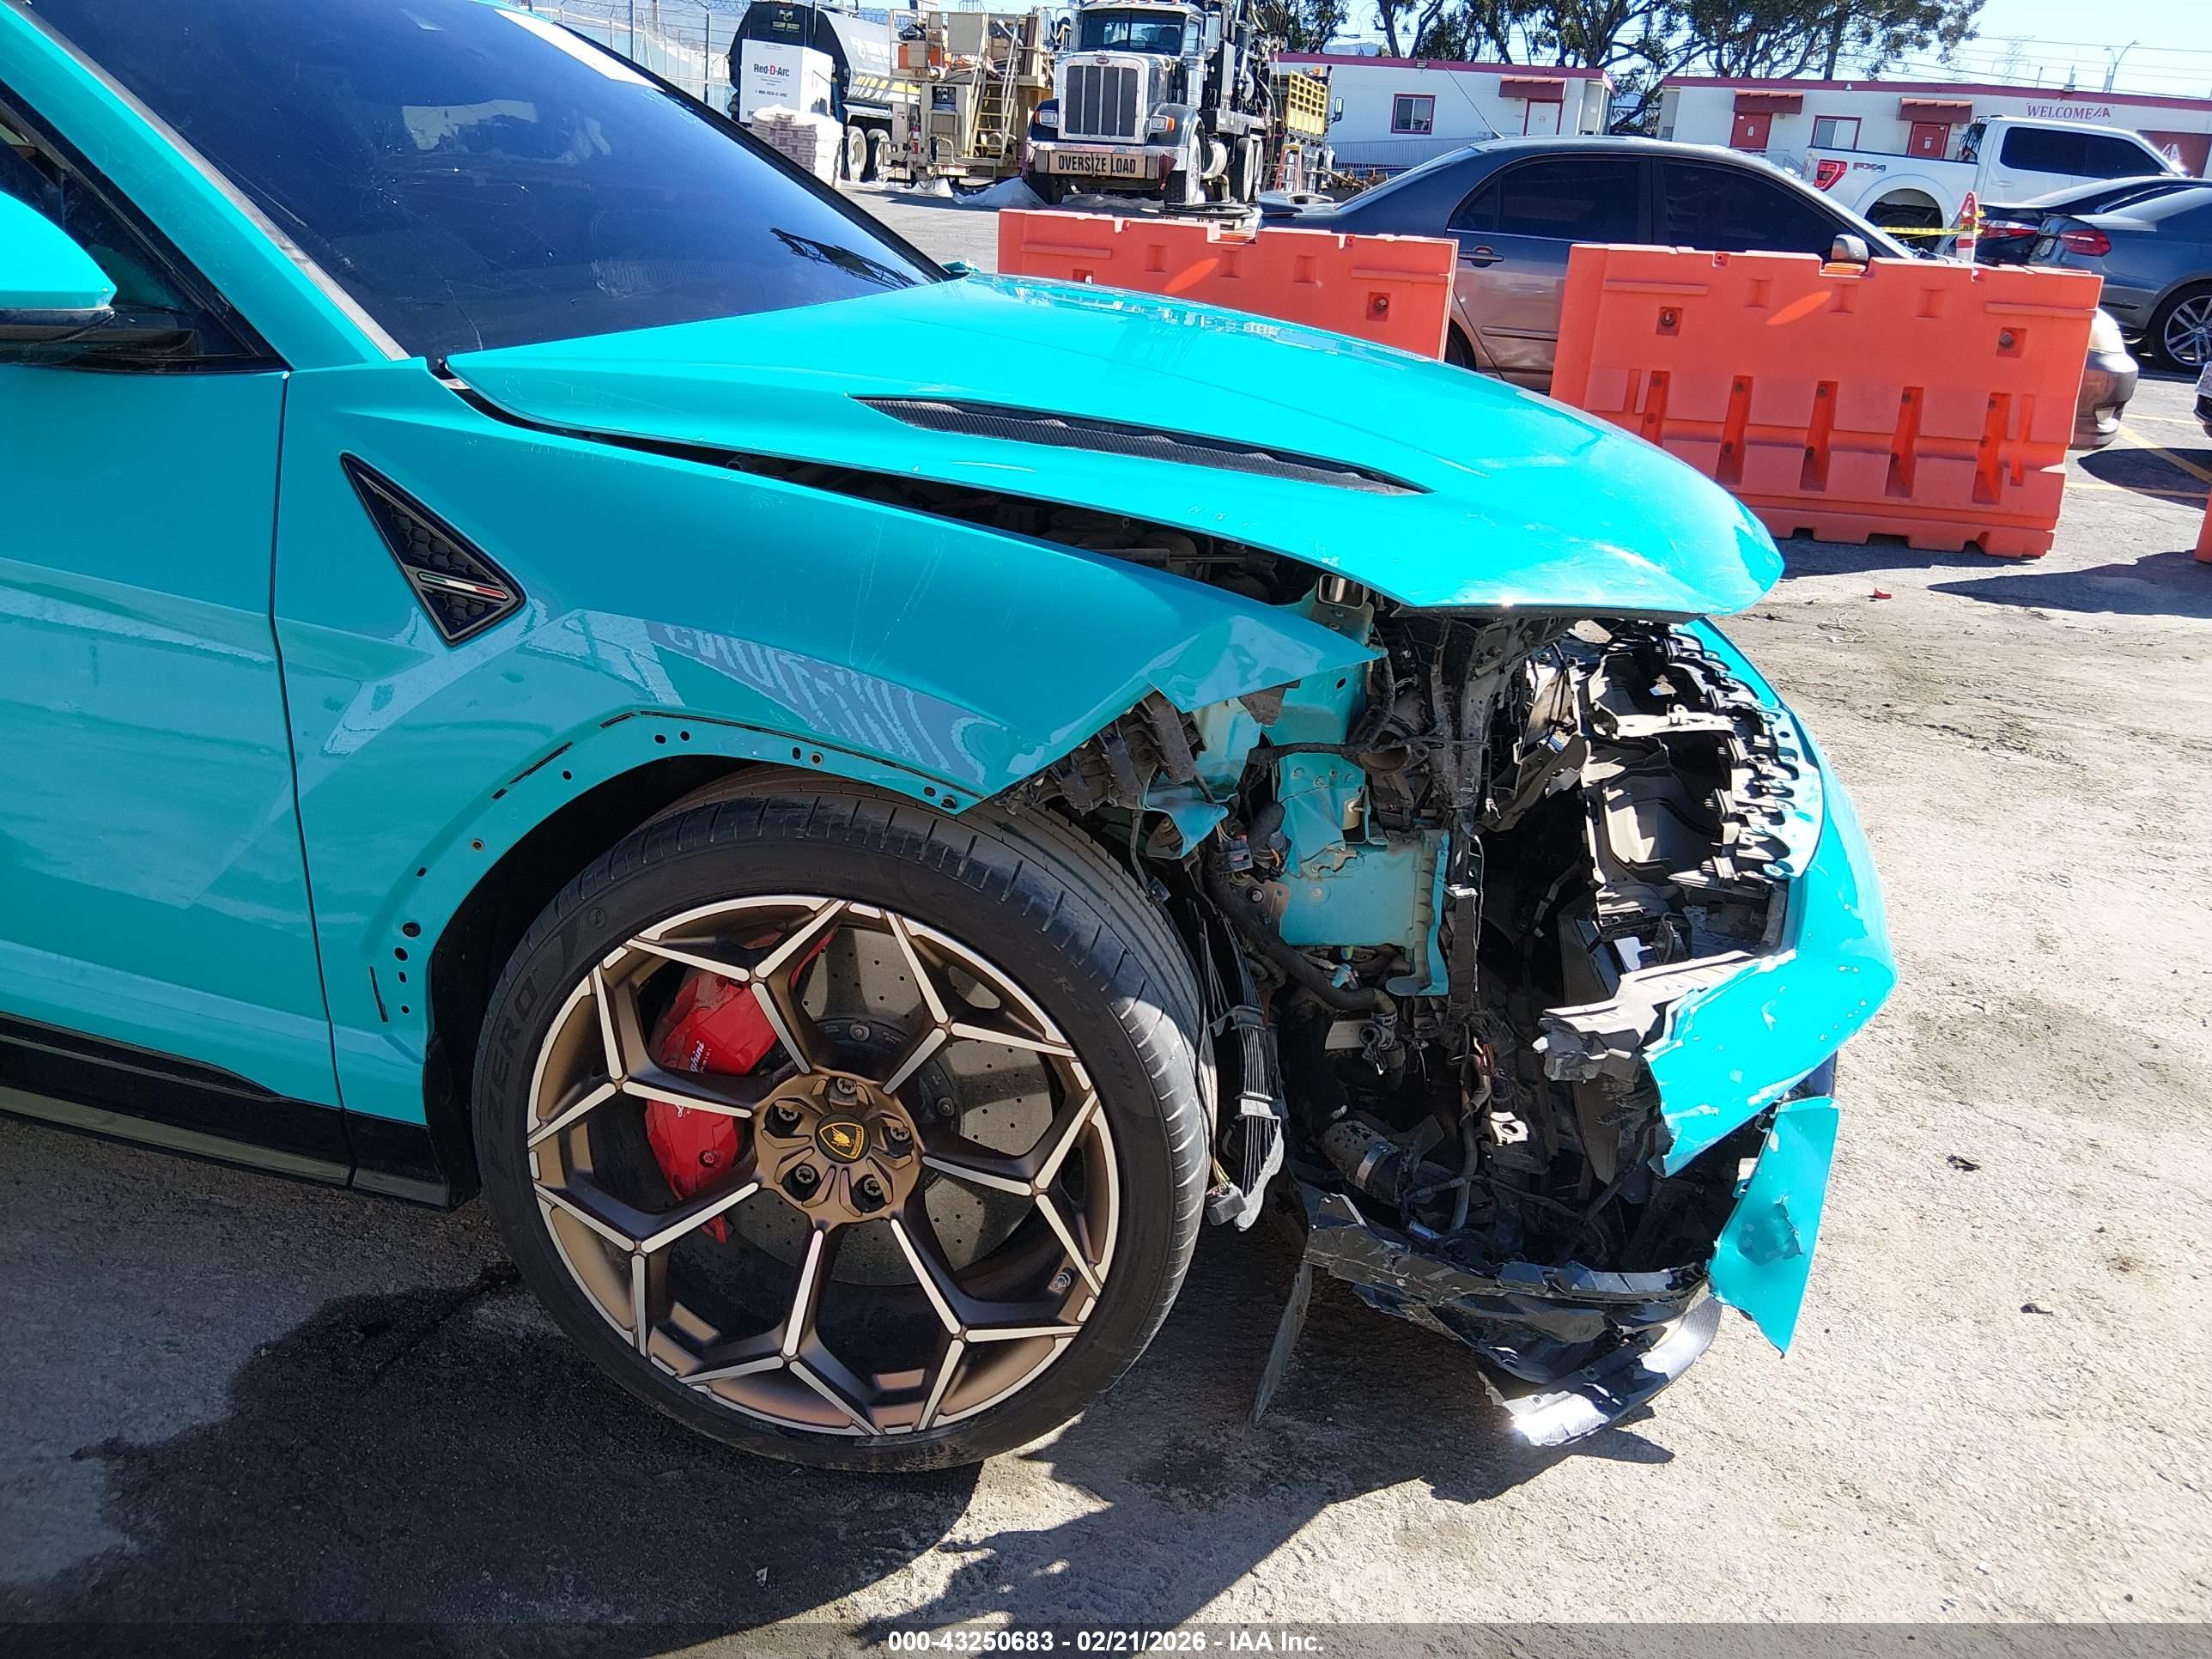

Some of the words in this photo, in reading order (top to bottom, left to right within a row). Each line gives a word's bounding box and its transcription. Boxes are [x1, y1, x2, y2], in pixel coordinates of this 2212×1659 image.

[2027, 104, 2094, 120] WELCOME
[1058, 155, 1107, 173] OVERSIZE
[1111, 156, 1136, 174] LOAD
[1852, 161, 1887, 173] FX4
[488, 975, 538, 1132] ZERO
